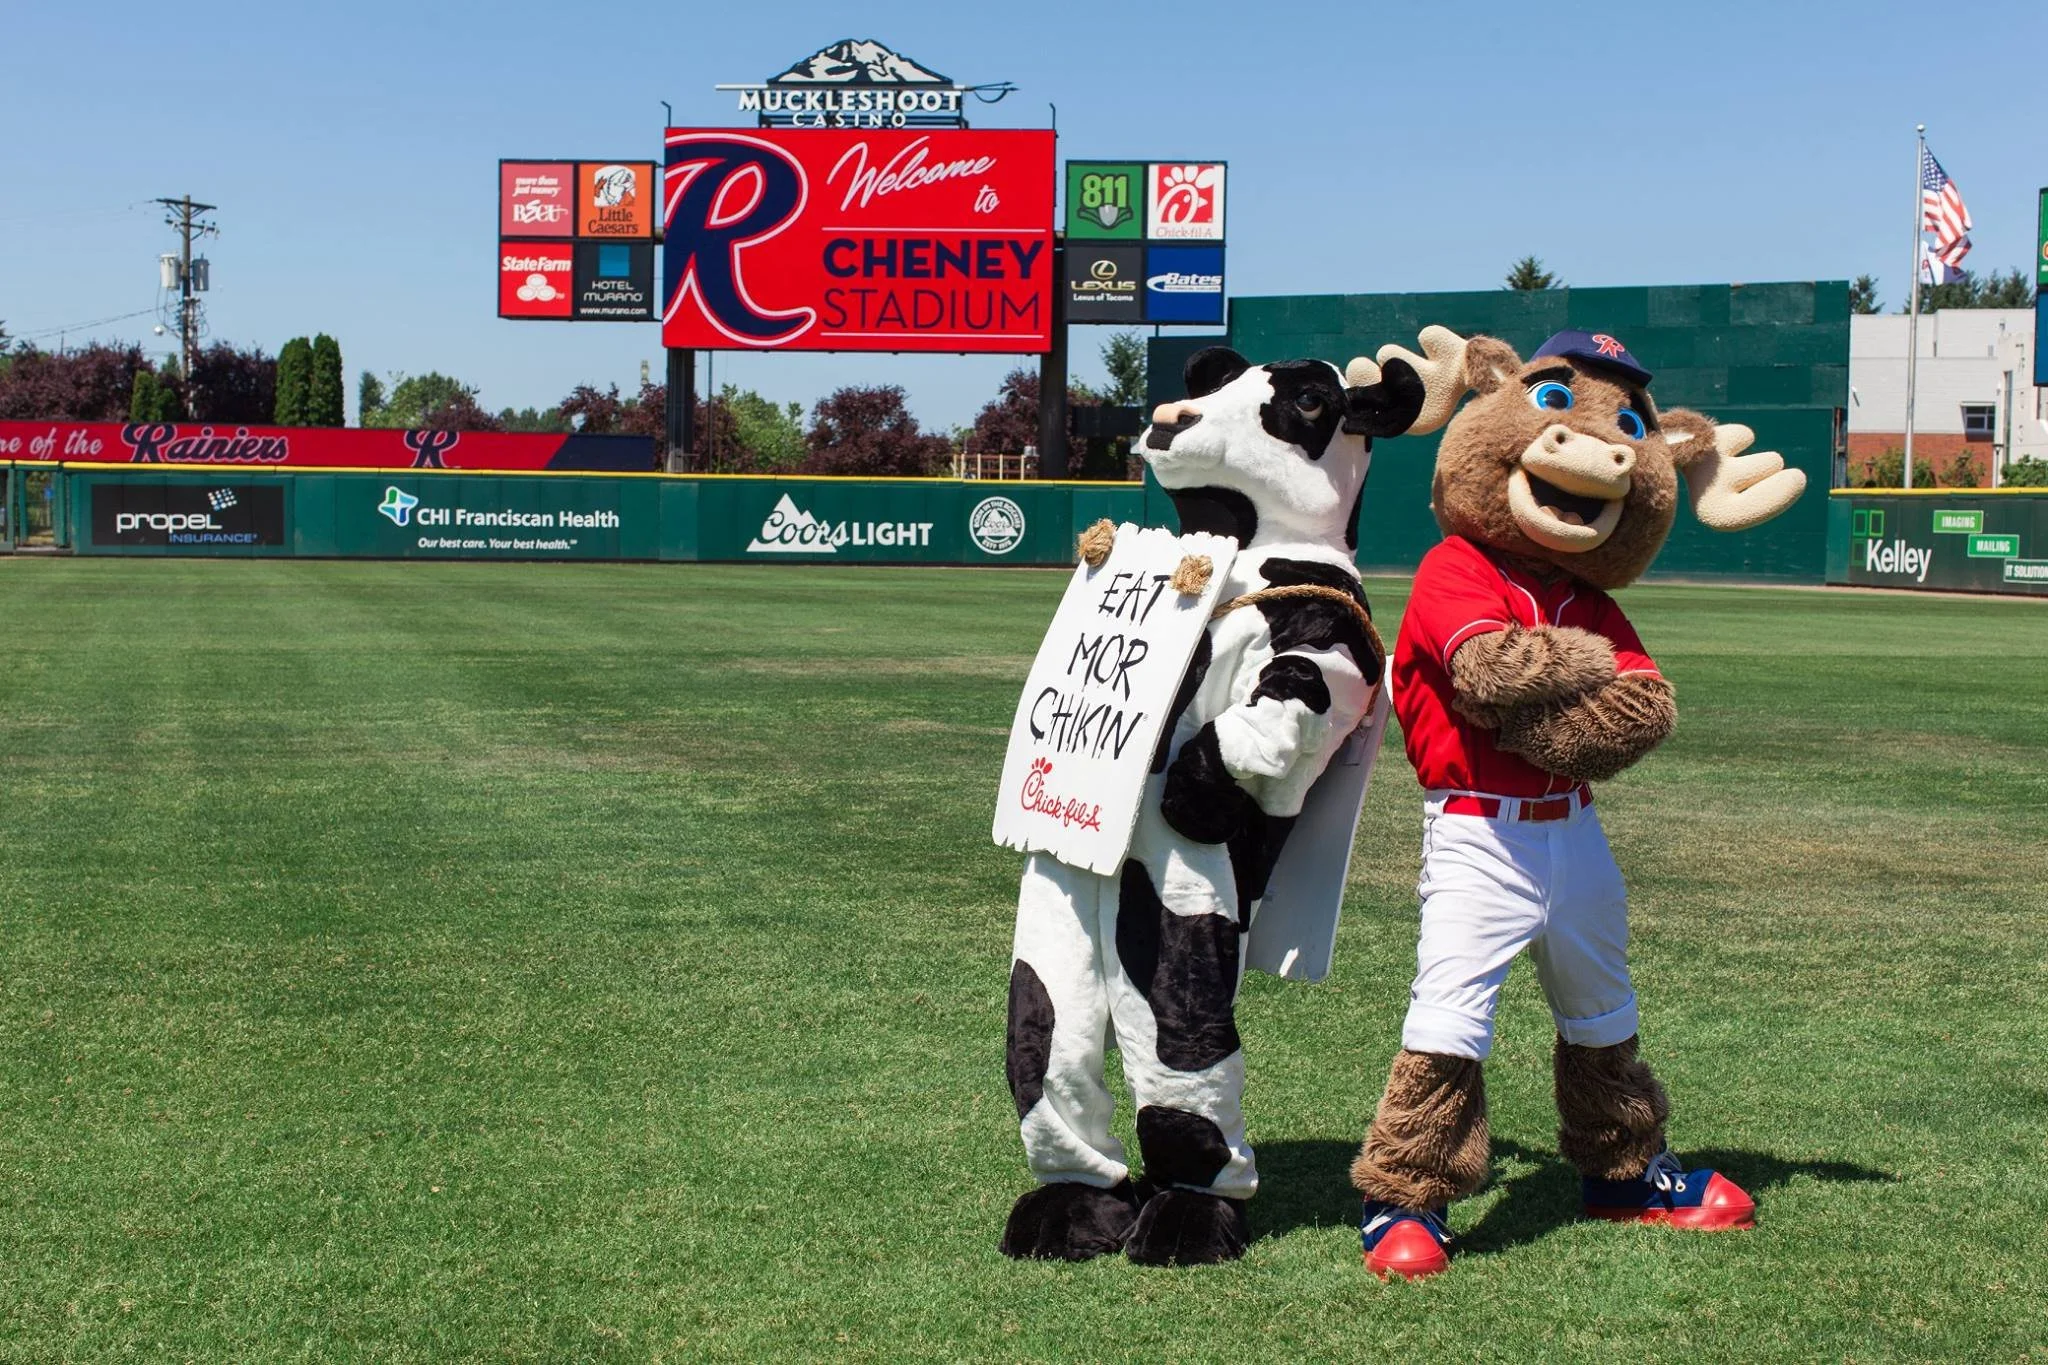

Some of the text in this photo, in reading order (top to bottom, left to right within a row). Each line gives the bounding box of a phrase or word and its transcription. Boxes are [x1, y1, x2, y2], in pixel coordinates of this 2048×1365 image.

[738, 91, 962, 112] MUCKLESHOOT
[792, 112, 907, 128] CASINO
[827, 136, 997, 212] Welcome
[973, 184, 1000, 213] to
[1082, 174, 1128, 209] 811
[598, 207, 633, 222] Little
[588, 220, 639, 234] Caesars
[822, 238, 1044, 280] CHENEY
[592, 280, 635, 290] HOTEL
[1071, 280, 1136, 291] LEXUS
[1166, 272, 1223, 286] Bates
[1073, 293, 1135, 301] Lexus of Tacoma
[580, 307, 648, 315] www.murano.com
[822, 287, 1040, 331] STADIUM
[29, 427, 56, 460] of
[64, 429, 103, 455] the
[121, 424, 289, 463] Rainiers
[116, 512, 222, 533] propel
[416, 508, 620, 528] CHI Franciscan Health
[1941, 516, 1976, 528] IMAGING
[169, 533, 254, 543] INSURANCE
[756, 510, 934, 547] Coors LIGHT
[417, 537, 438, 548] Our
[439, 537, 461, 548] best
[462, 539, 487, 549] care.
[489, 538, 512, 549] Your
[513, 540, 535, 549] best
[1976, 540, 2011, 553] MAILING
[1866, 539, 1932, 583] Kelley
[2005, 565, 2013, 576] IT
[1098, 570, 1171, 627] EAT
[1067, 632, 1149, 701] MOR
[1029, 687, 1146, 761] CHIKIN
[1021, 769, 1101, 832] Chick-fil-A
